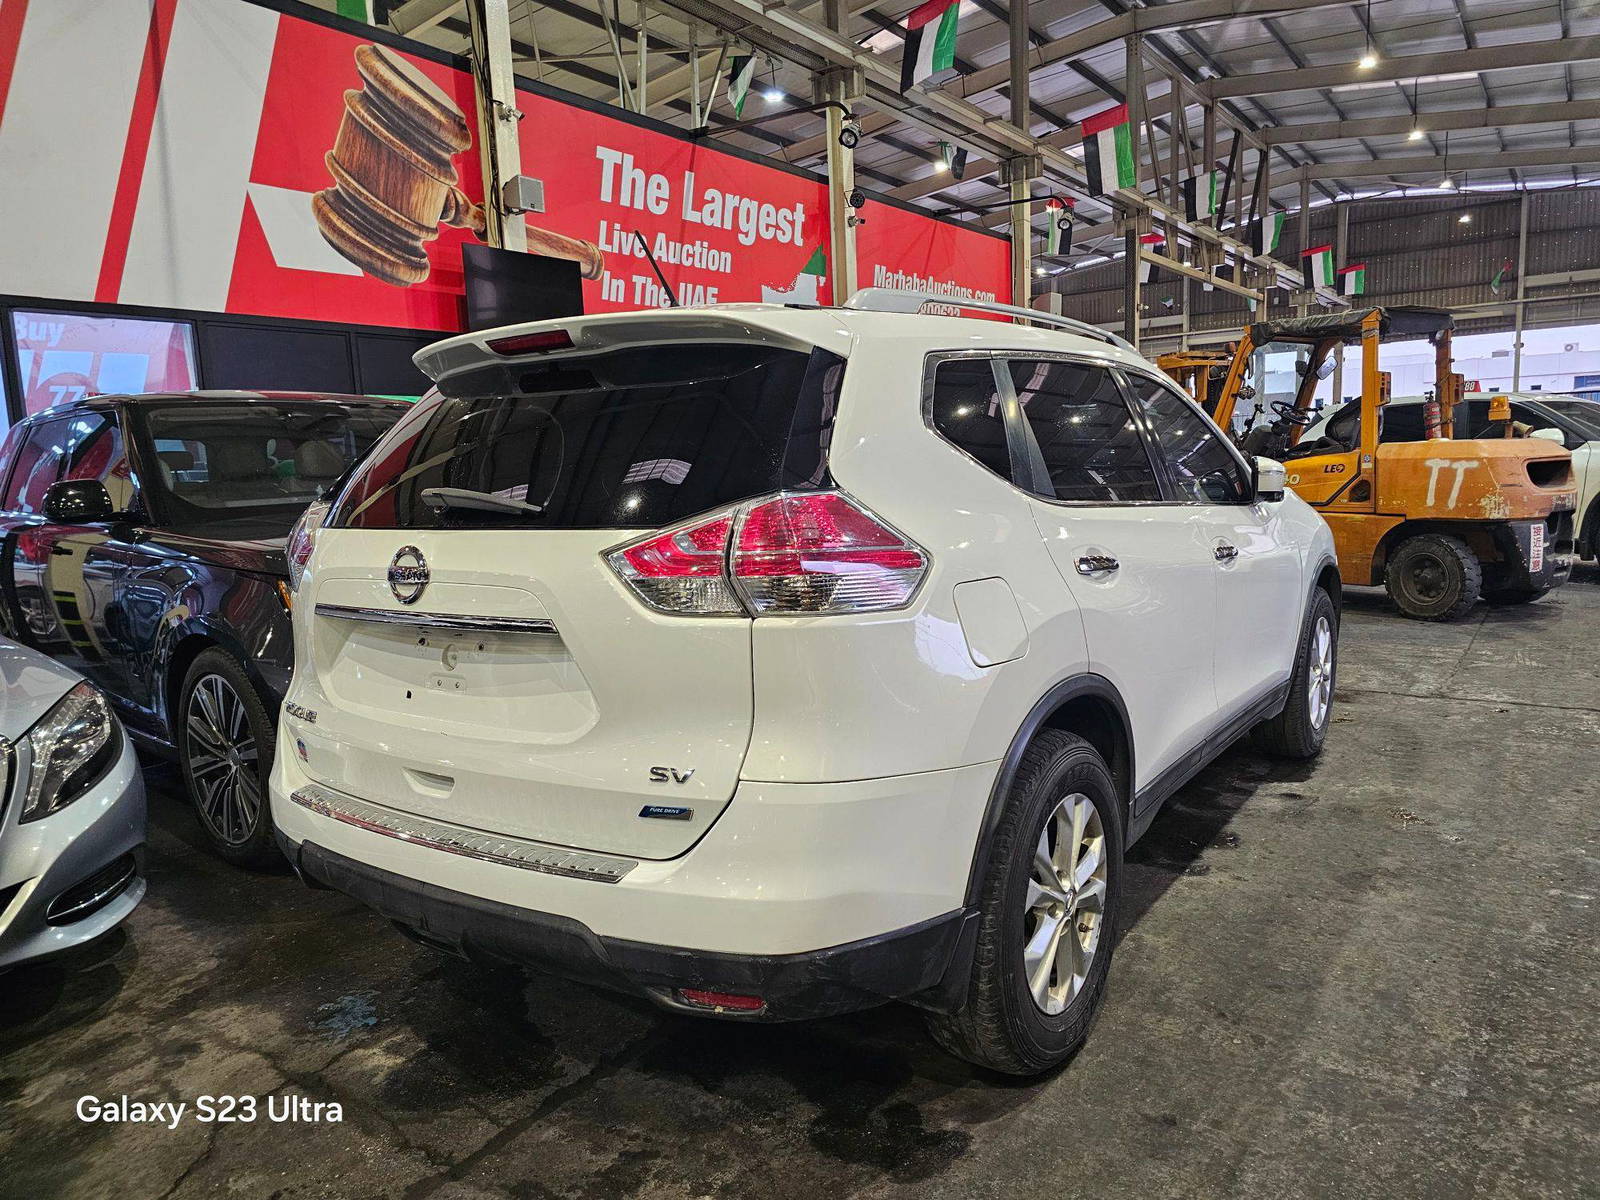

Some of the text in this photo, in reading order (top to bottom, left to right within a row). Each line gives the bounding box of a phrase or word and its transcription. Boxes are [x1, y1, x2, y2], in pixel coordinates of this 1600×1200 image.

[596, 145, 805, 247] The Largest
[598, 220, 732, 274] Live Auction
[601, 270, 625, 302] In
[632, 274, 672, 308] The
[873, 264, 996, 303] MarhabaAuctionscom
[15, 315, 65, 346] Buy
[1323, 463, 1346, 474] LEO
[649, 766, 695, 784] SV
